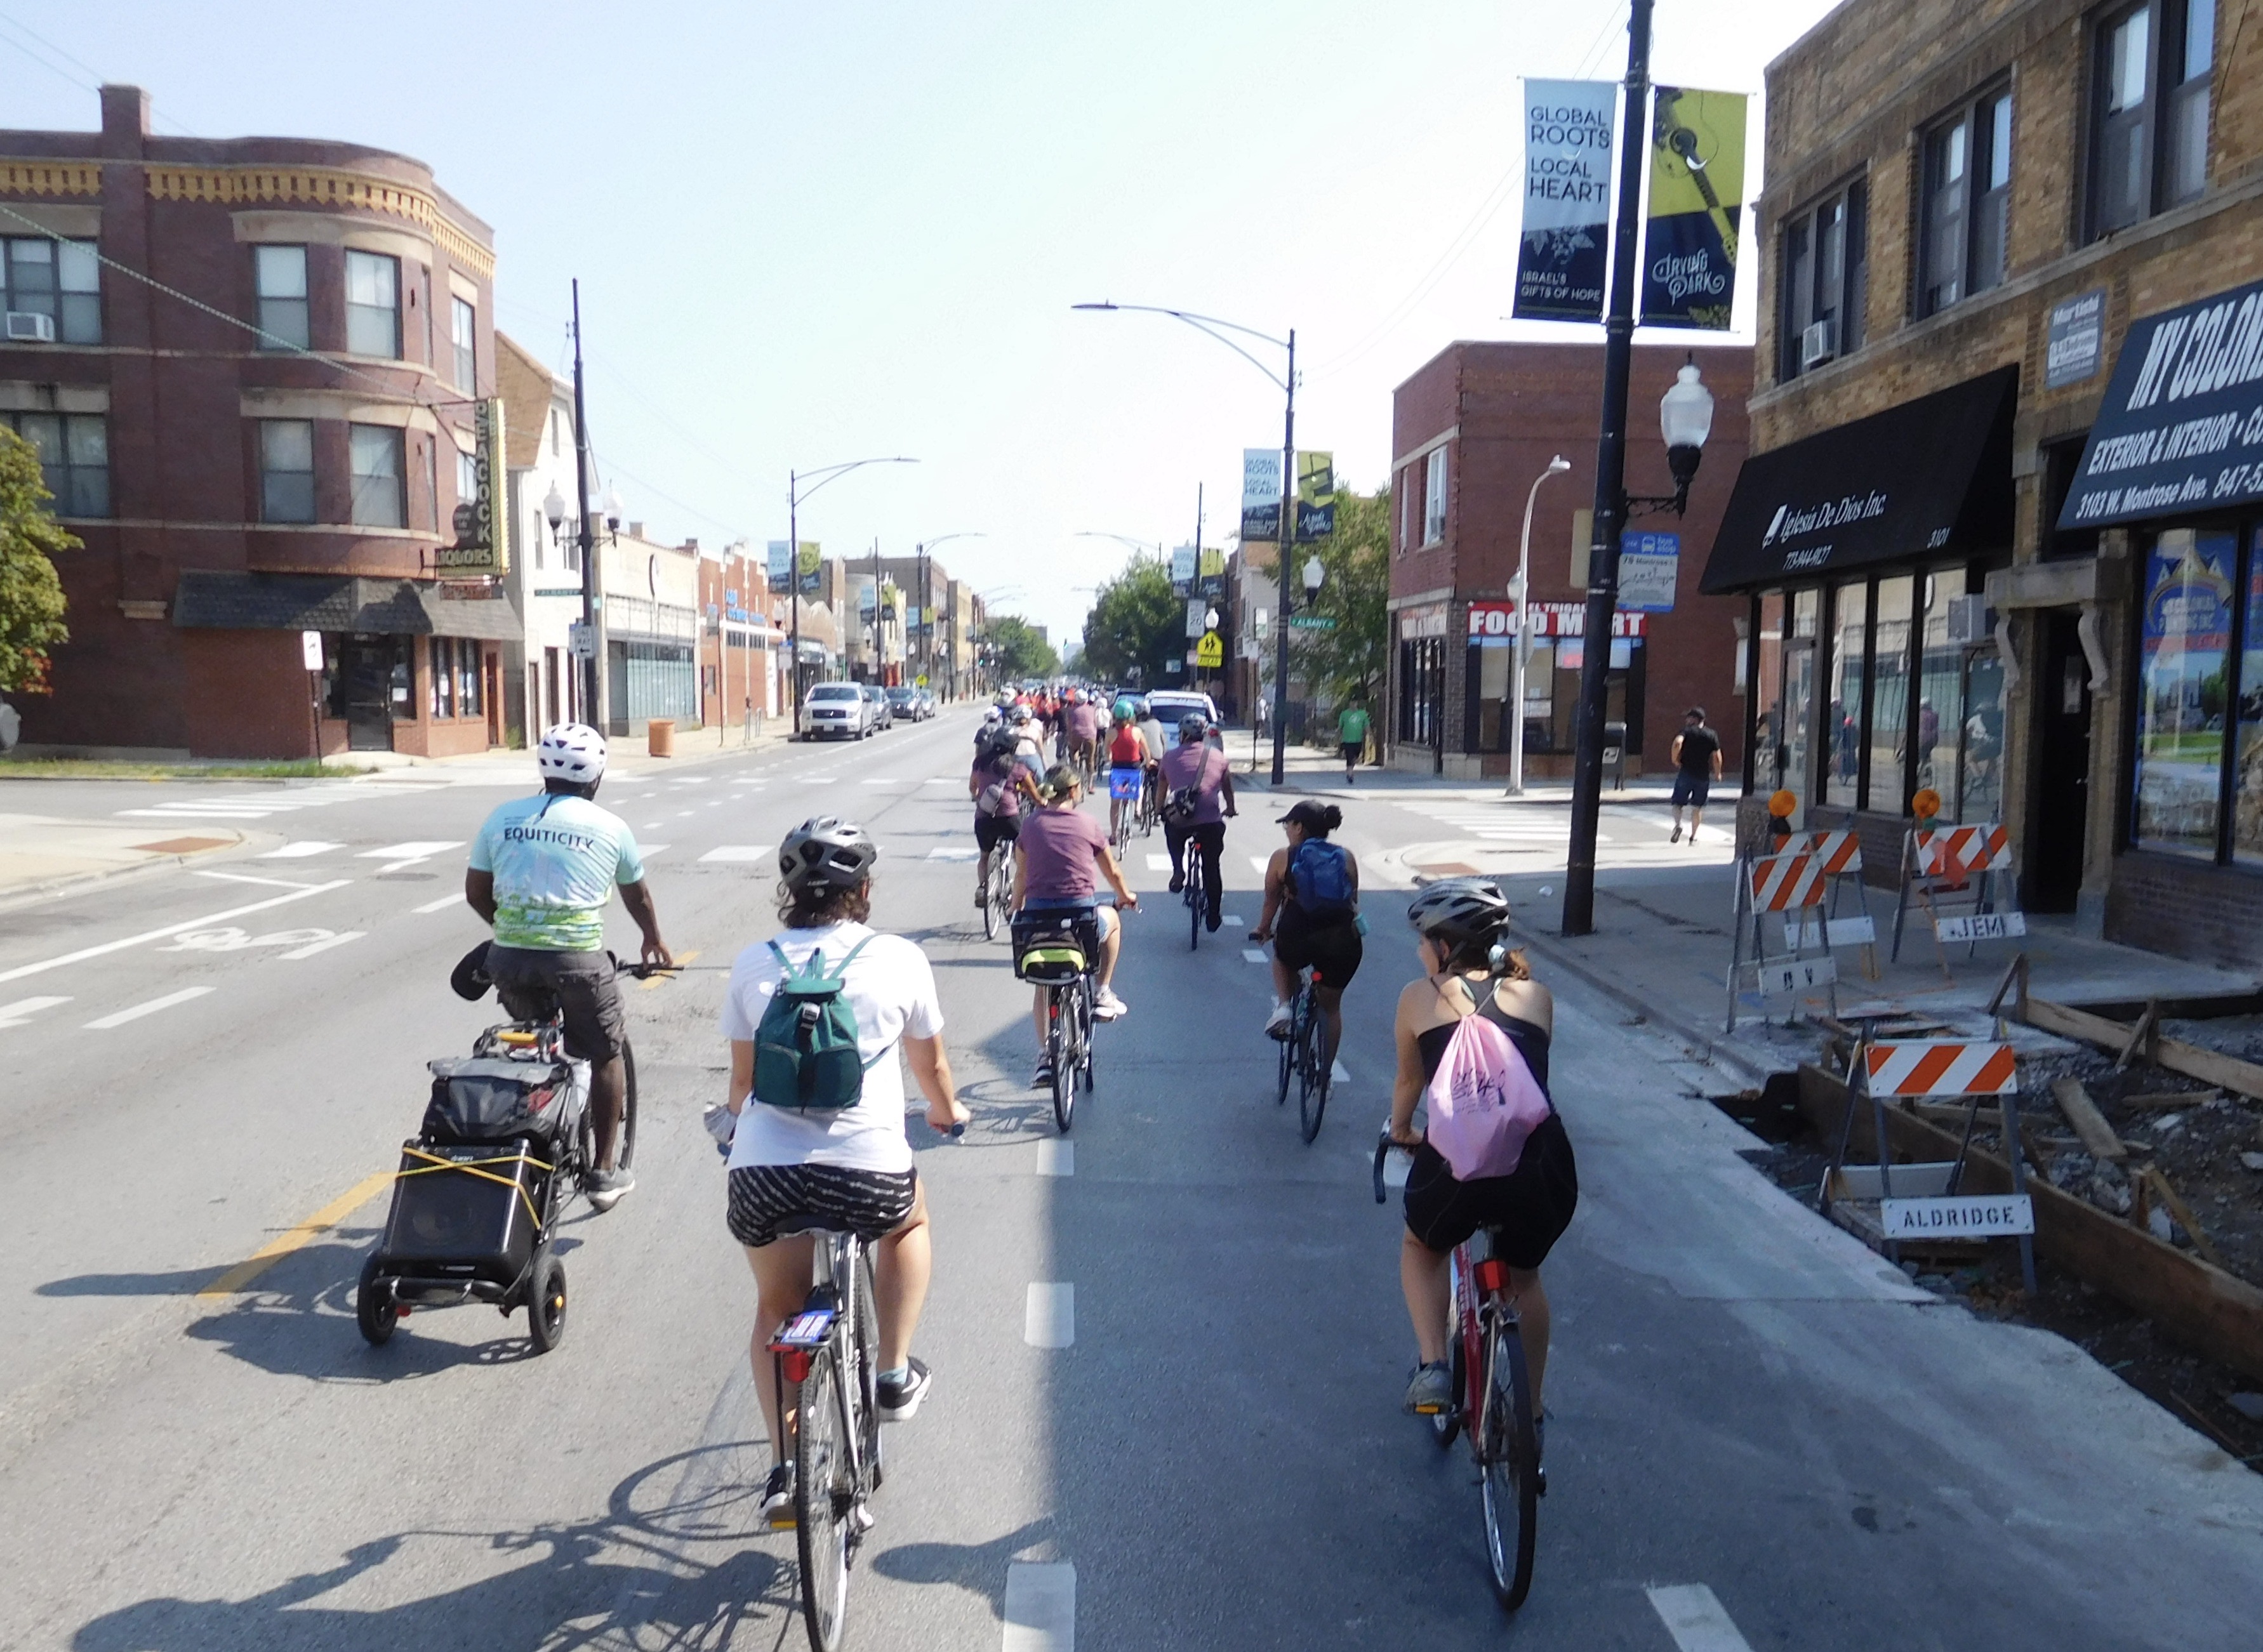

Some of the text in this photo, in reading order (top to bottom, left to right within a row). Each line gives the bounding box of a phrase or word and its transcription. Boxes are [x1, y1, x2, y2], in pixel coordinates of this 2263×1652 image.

[1530, 105, 1606, 127] GLOBAL
[1530, 126, 1610, 150] ROOTS
[1530, 157, 1592, 178] LOCAL
[1529, 178, 1607, 204] HEART
[1522, 270, 1567, 285] ISRAEL'S
[1521, 284, 1600, 302] GIFTS OF HOPE
[2126, 315, 2191, 411] MY
[2087, 429, 2156, 475] EXTERIOR
[2150, 425, 2168, 464] &
[2163, 411, 2238, 462] INTERIOR
[2076, 489, 2108, 519] 3103
[2120, 482, 2181, 513] Montrose
[1779, 505, 1817, 543] Iglesia
[1815, 502, 1836, 529] De
[1833, 494, 1864, 525] Dios
[1927, 526, 1950, 548] 3101
[1528, 602, 1541, 613] EL
[1469, 610, 1548, 635] FOOD
[1556, 612, 1645, 637] MRT
[505, 826, 594, 849] EQUITICITY
[1904, 1206, 2014, 1228] ALDRIDGE
